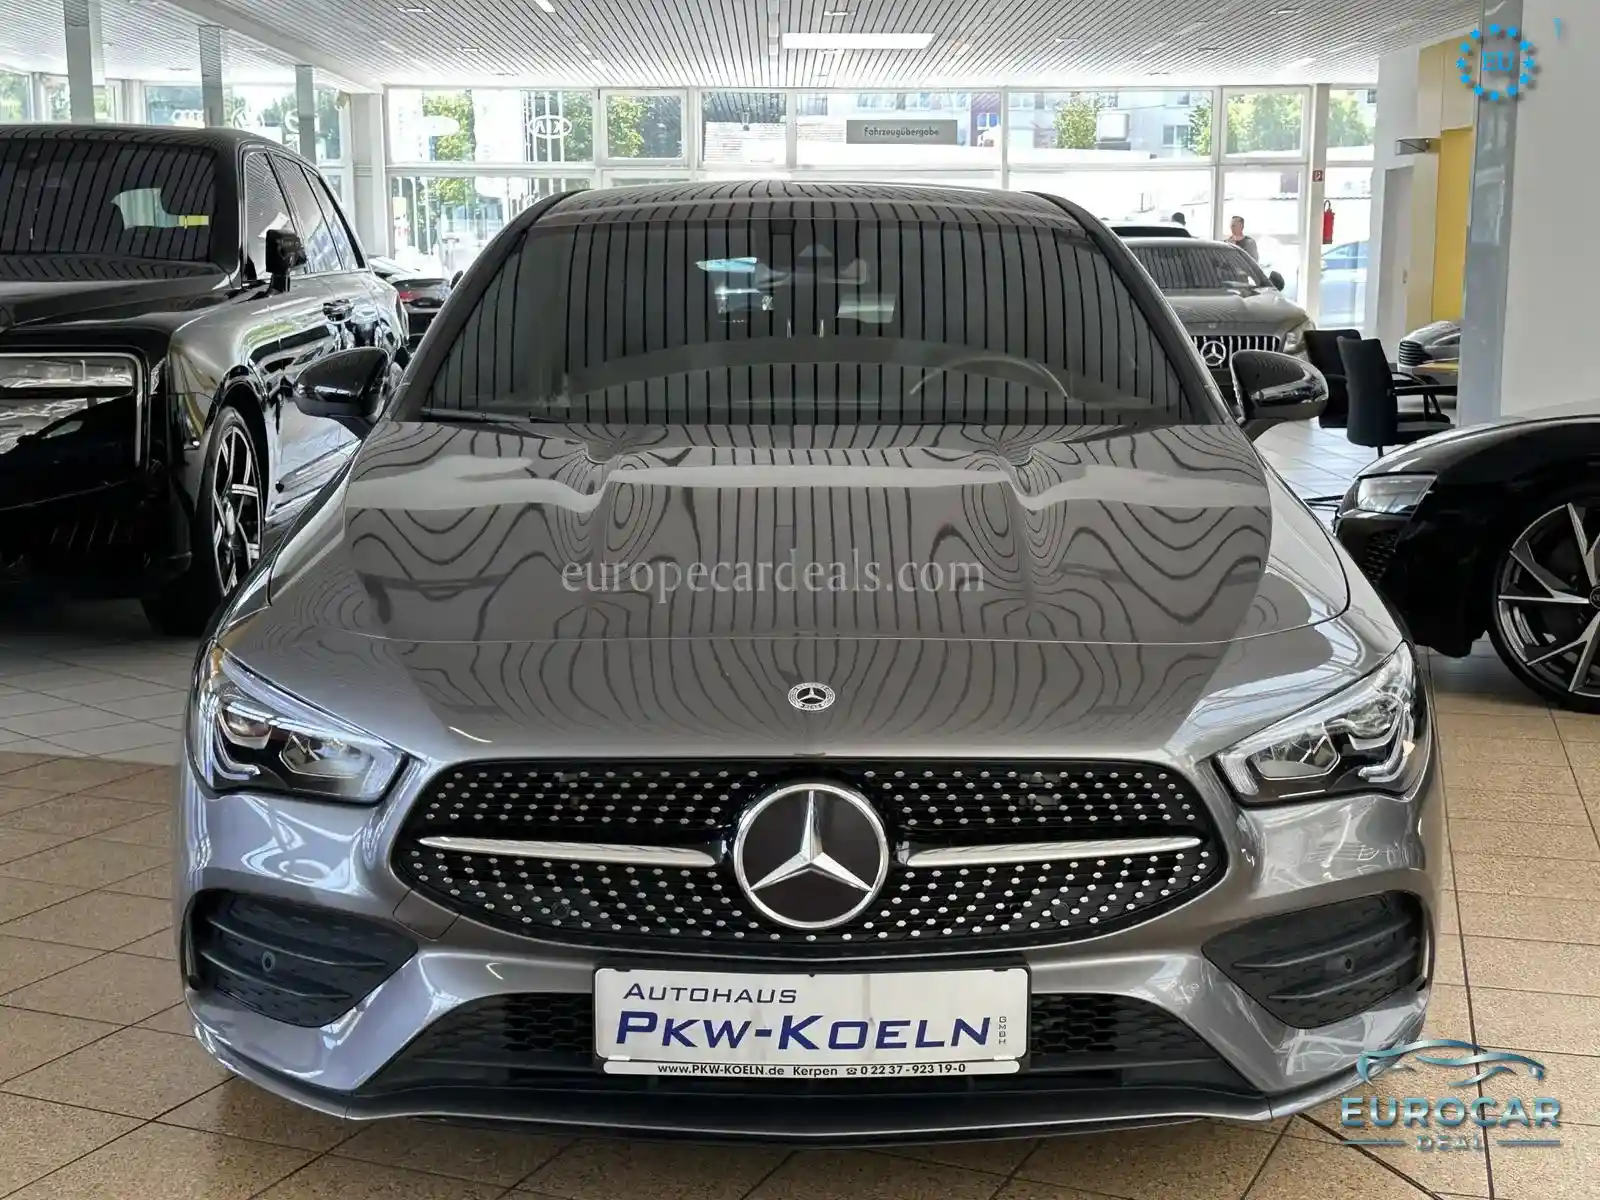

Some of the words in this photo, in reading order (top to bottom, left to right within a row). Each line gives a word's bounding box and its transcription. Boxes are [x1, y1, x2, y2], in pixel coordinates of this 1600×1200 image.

[623, 982, 798, 1004] AUTOHAUS
[616, 1010, 991, 1051] PKW-KOELN
[998, 1015, 1007, 1045] GMBH
[658, 1064, 785, 1076] www.PKW-KOELN.de
[793, 1065, 838, 1077] Kerpen
